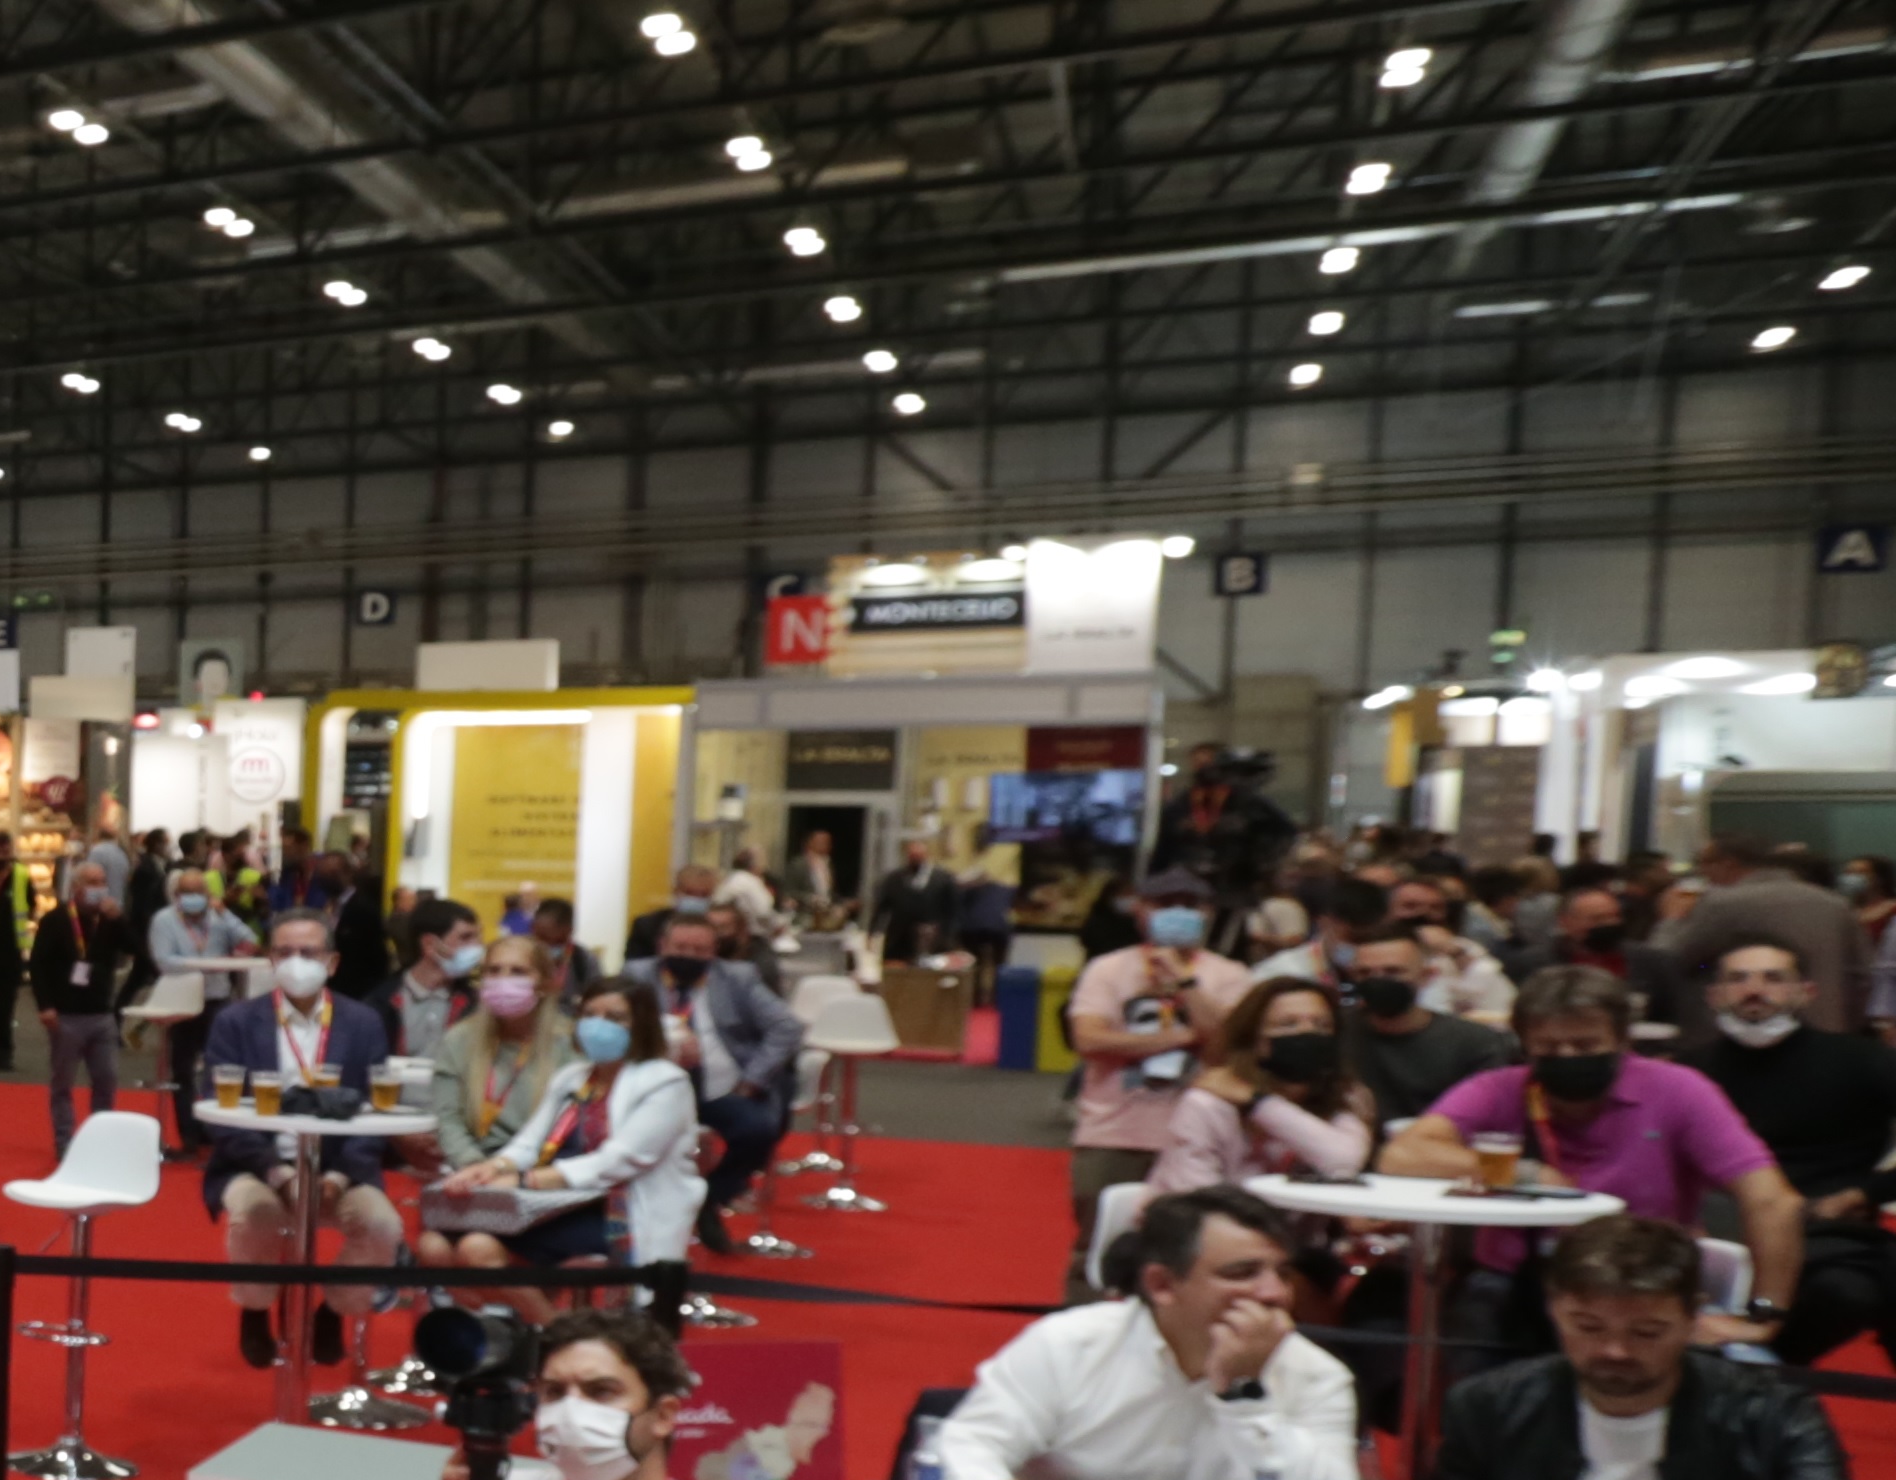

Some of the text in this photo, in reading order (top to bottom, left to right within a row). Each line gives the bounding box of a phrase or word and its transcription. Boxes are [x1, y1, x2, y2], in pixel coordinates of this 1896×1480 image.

[1827, 530, 1877, 565] A
[1222, 557, 1257, 593] B
[361, 592, 390, 622] D
